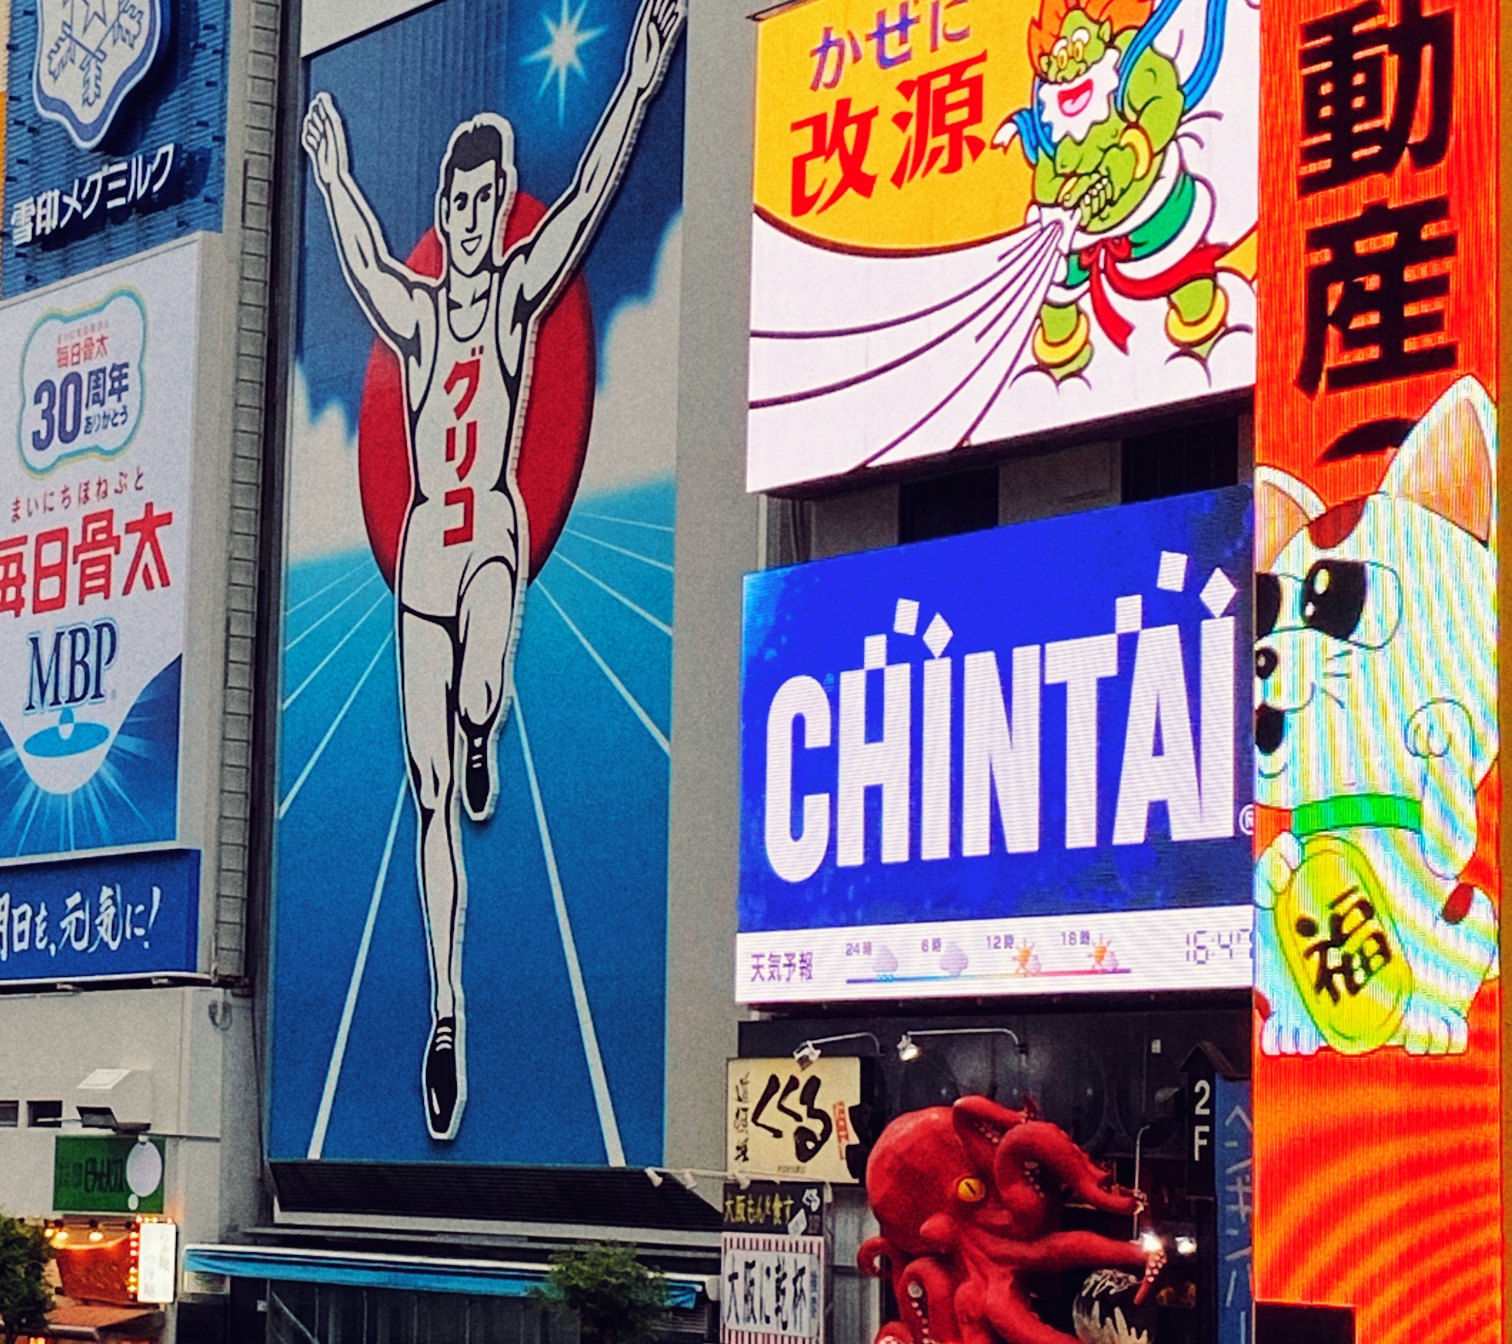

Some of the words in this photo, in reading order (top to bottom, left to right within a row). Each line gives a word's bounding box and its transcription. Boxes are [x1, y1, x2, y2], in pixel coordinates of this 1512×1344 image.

[787, 46, 989, 220] 改源
[9, 140, 177, 249] 雪印メグミルク
[55, 333, 110, 369] 毎日骨太
[31, 361, 130, 452] 30周年
[83, 404, 129, 436] ありがとう
[441, 346, 486, 550] グリコ
[10, 464, 145, 525] まいにちほねぶと
[23, 619, 119, 718] MBP
[765, 549, 1237, 883] CHINTAI
[749, 950, 814, 983] 天気予報
[1296, 885, 1395, 1008] 福
[750, 1073, 833, 1164] くくる
[1193, 1078, 1211, 1162] 2F
